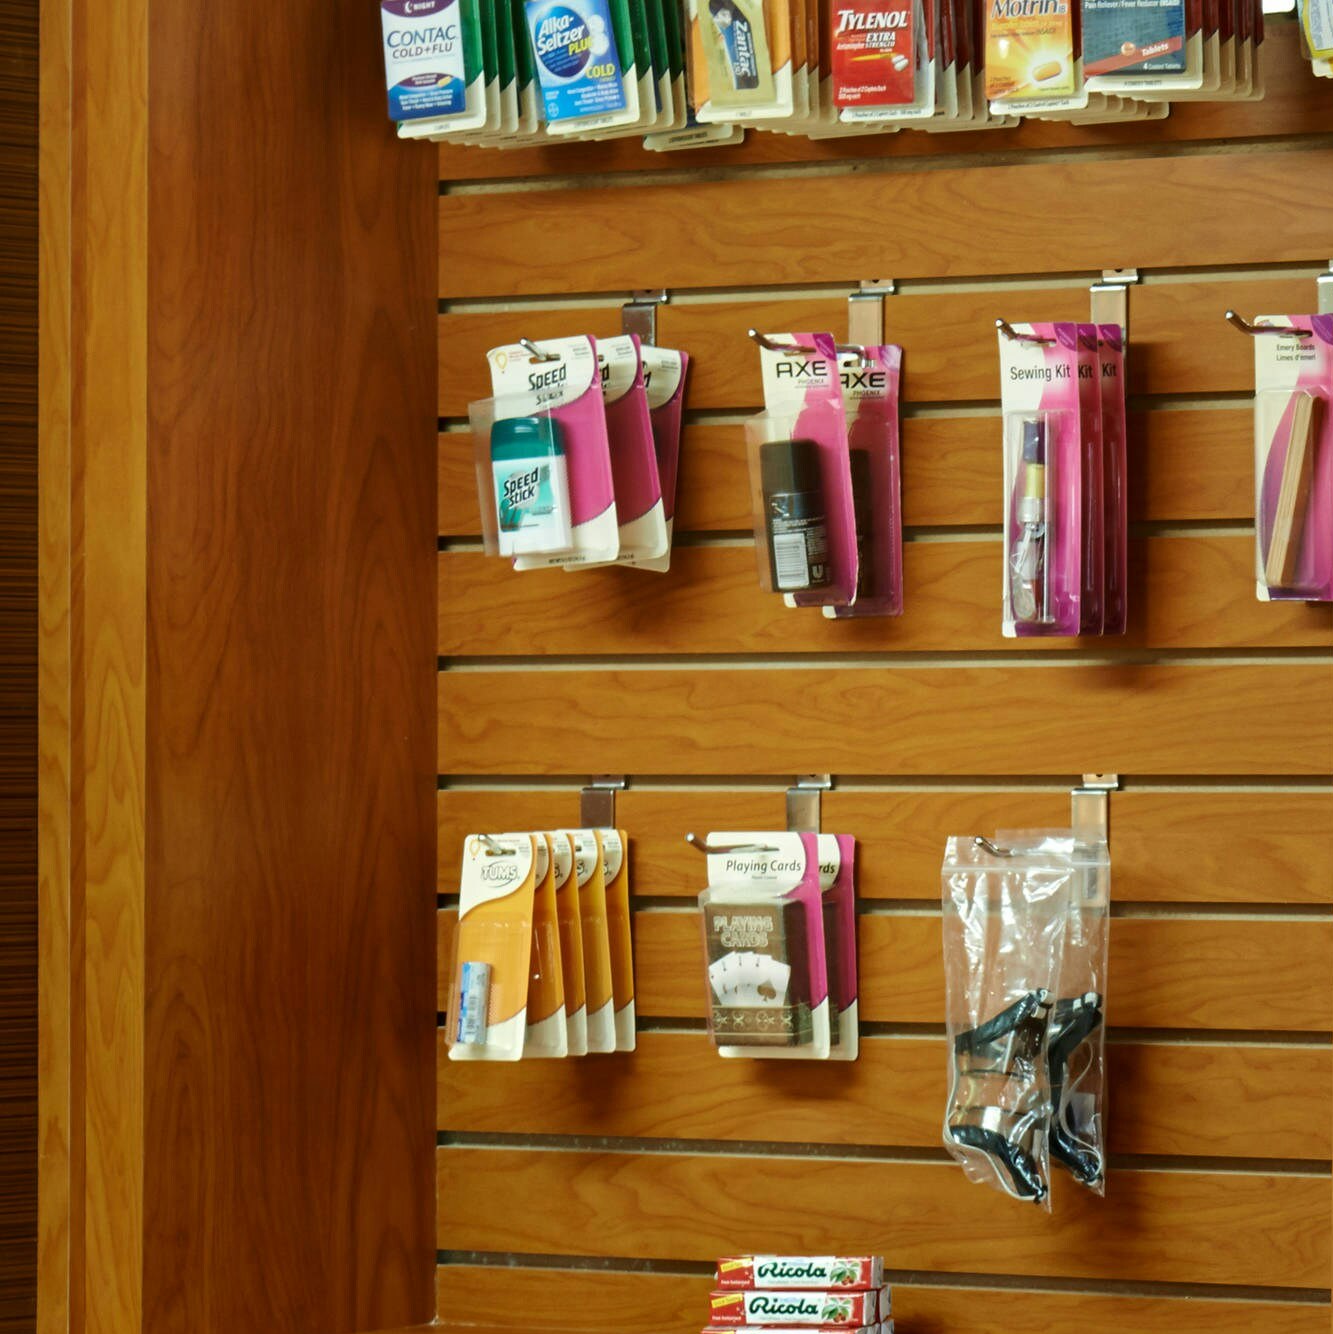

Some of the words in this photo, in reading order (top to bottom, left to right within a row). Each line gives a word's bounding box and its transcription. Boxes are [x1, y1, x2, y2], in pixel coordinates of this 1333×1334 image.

[537, 14, 574, 38] Alka-
[836, 10, 909, 35] TYLENOL
[387, 24, 457, 48] CONTAC
[537, 24, 585, 55] Seltzer
[866, 32, 896, 42] EXTRA
[392, 42, 453, 59] COLD+FLU
[735, 20, 751, 77] Zantac
[585, 64, 616, 78] COLD
[776, 361, 828, 379] AXE
[1010, 366, 1052, 382] Sewing
[1055, 364, 1071, 379] Kit
[1078, 365, 1093, 379] Kit
[1102, 363, 1117, 377] Kit
[481, 866, 518, 880] TUMS
[726, 860, 768, 874] Playing
[770, 860, 801, 872] Cards
[713, 915, 774, 932] PLAYING
[720, 931, 769, 948] CARDS
[758, 1262, 826, 1278] Ricola
[749, 1297, 819, 1314] Ricola
